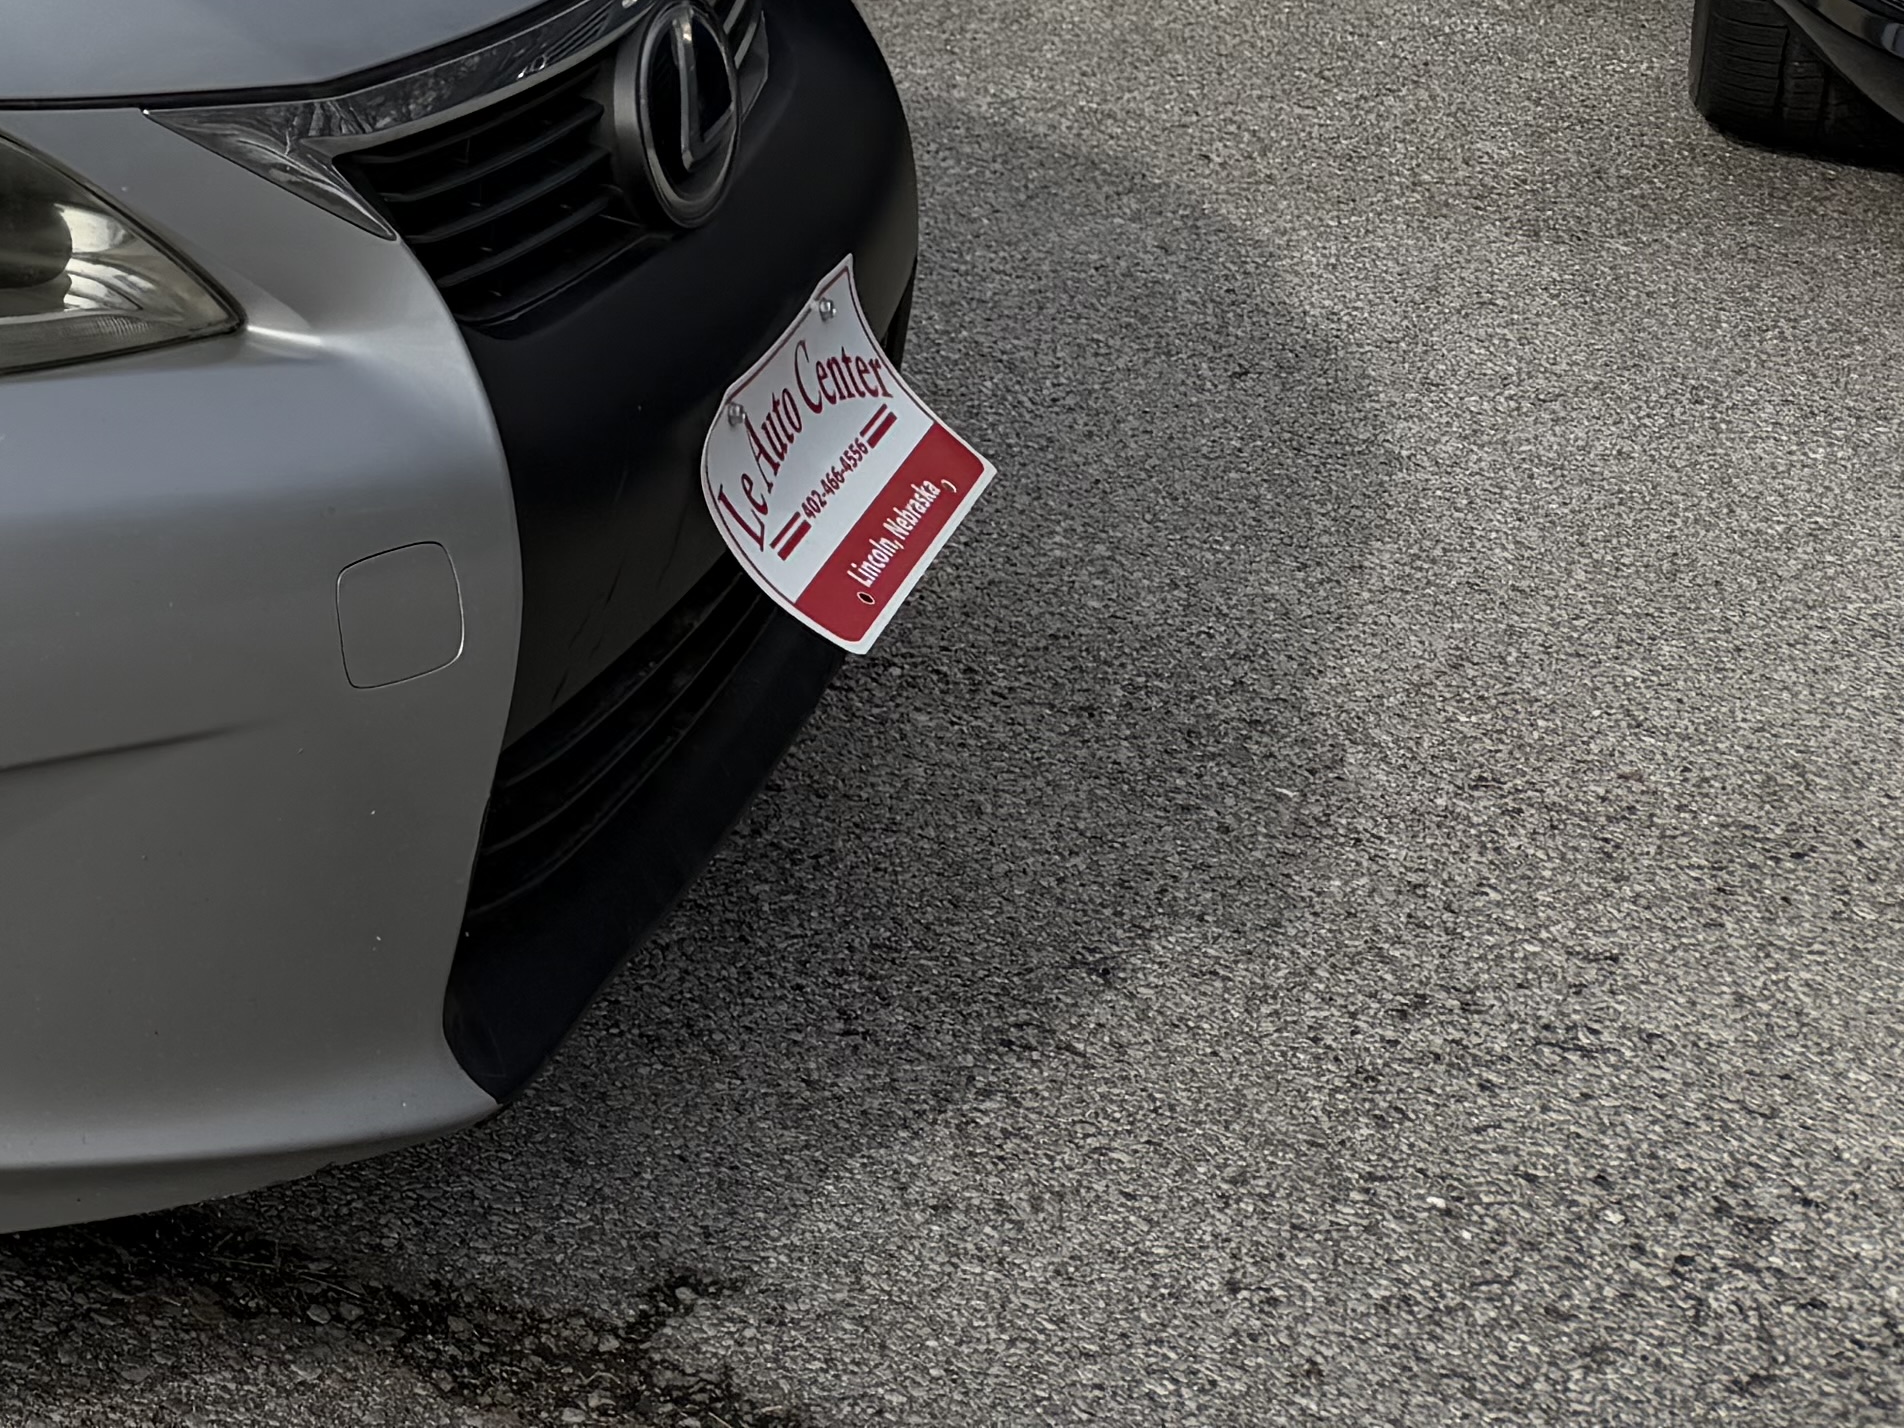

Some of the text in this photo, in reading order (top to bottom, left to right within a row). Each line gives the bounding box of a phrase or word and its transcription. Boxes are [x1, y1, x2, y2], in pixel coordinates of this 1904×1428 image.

[718, 341, 893, 552] Le Auto Center
[802, 437, 869, 520] 402-466-4556
[847, 480, 941, 587] Lincoln, Nebraska
